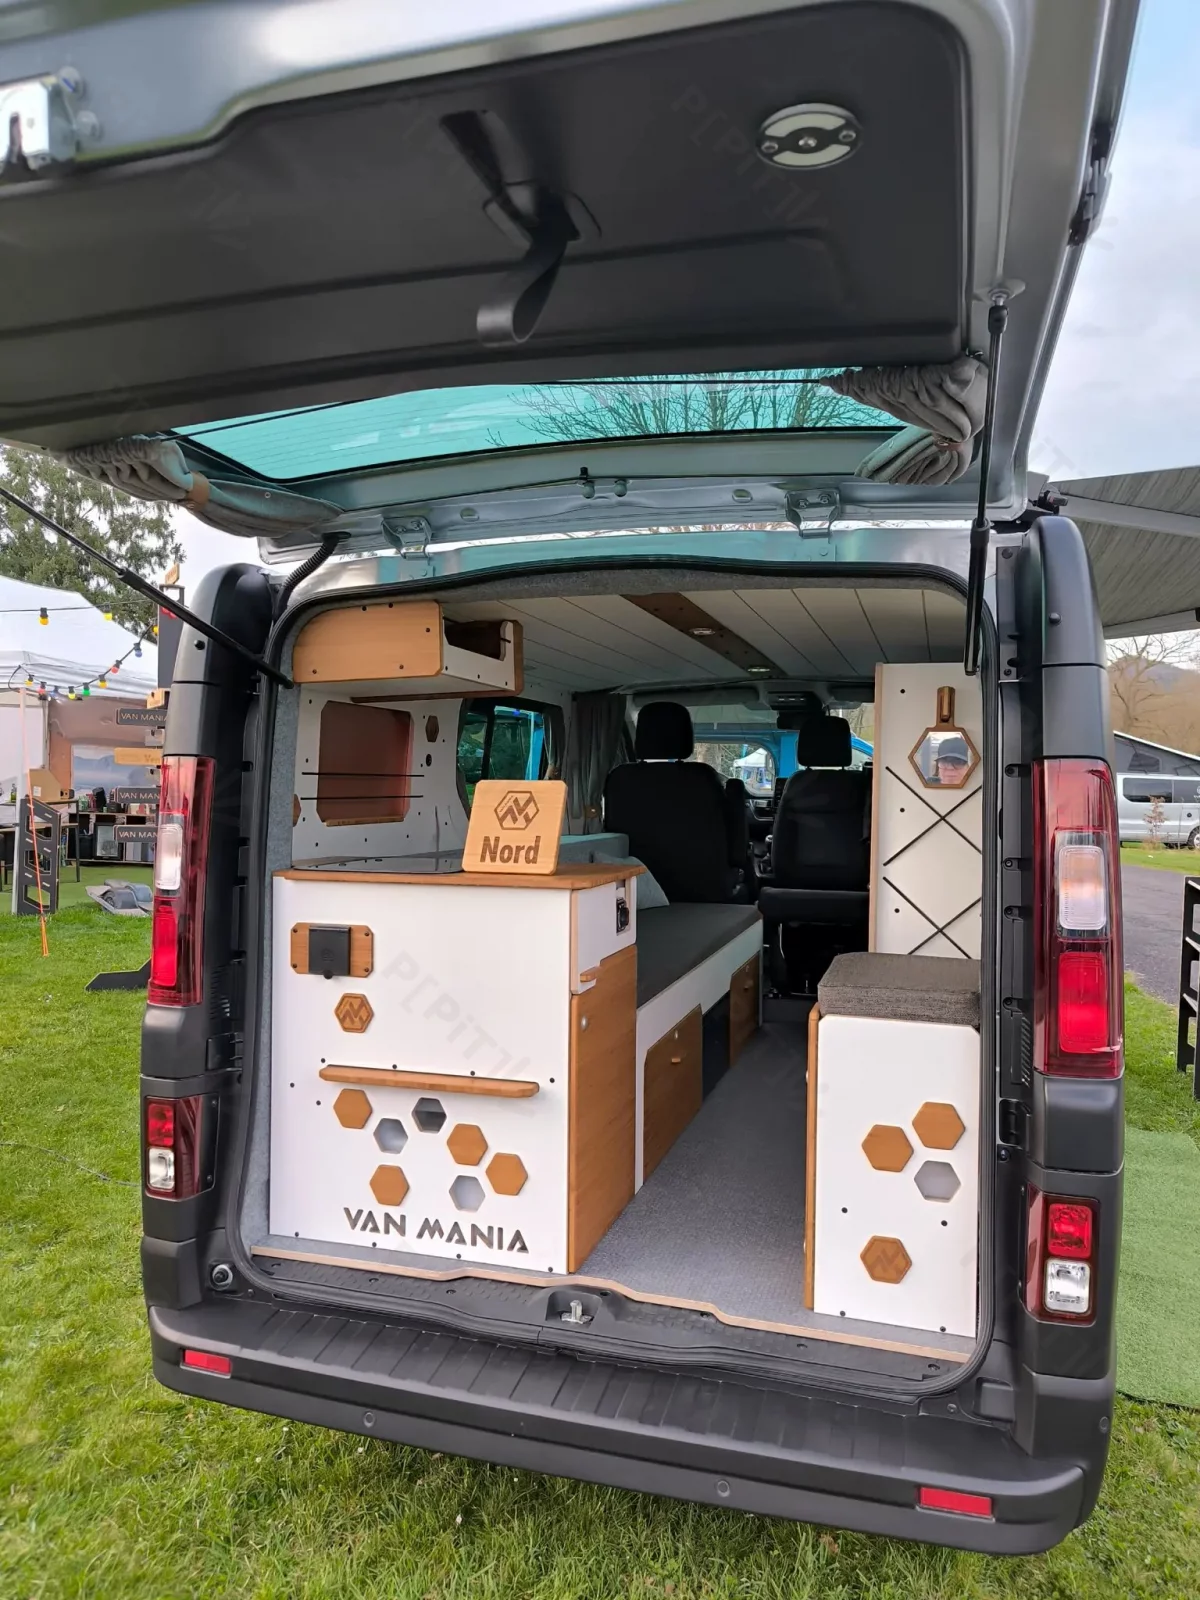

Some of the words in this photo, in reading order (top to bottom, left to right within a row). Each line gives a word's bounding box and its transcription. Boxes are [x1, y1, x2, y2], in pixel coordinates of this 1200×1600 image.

[480, 835, 542, 865] Nord
[343, 1207, 407, 1237] VAN
[415, 1217, 530, 1254] MANIA
